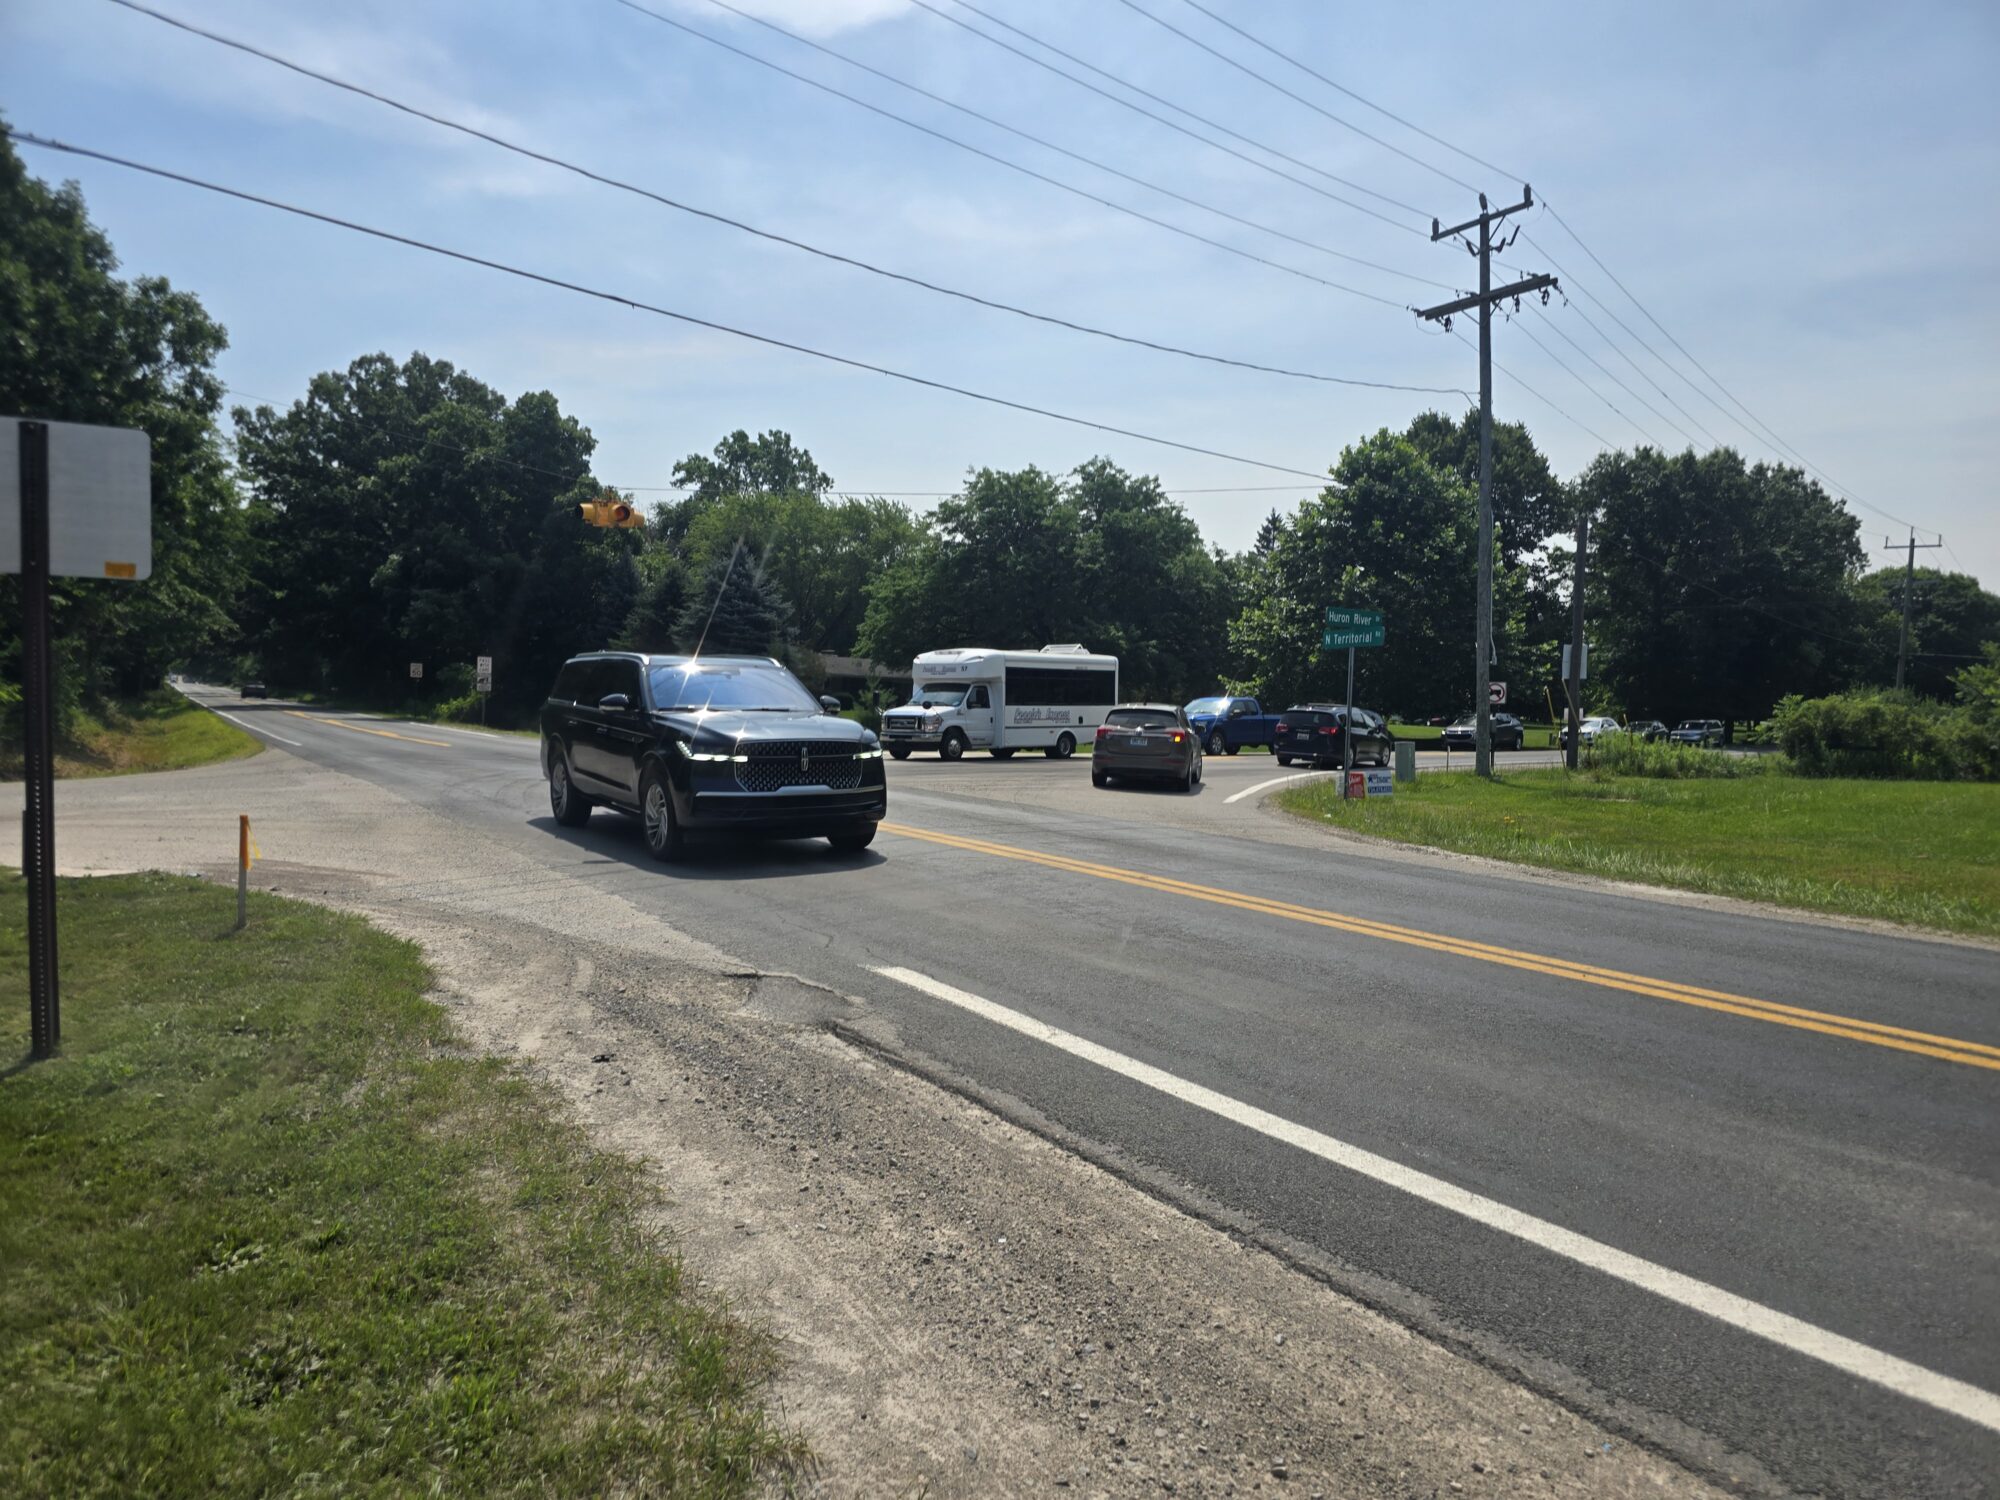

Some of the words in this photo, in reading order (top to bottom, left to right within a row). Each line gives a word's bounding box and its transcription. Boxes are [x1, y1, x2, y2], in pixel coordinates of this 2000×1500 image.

[1329, 611, 1350, 623] Huron
[1353, 613, 1372, 625] River
[1325, 633, 1331, 645] N
[1334, 632, 1372, 645] Territorial
